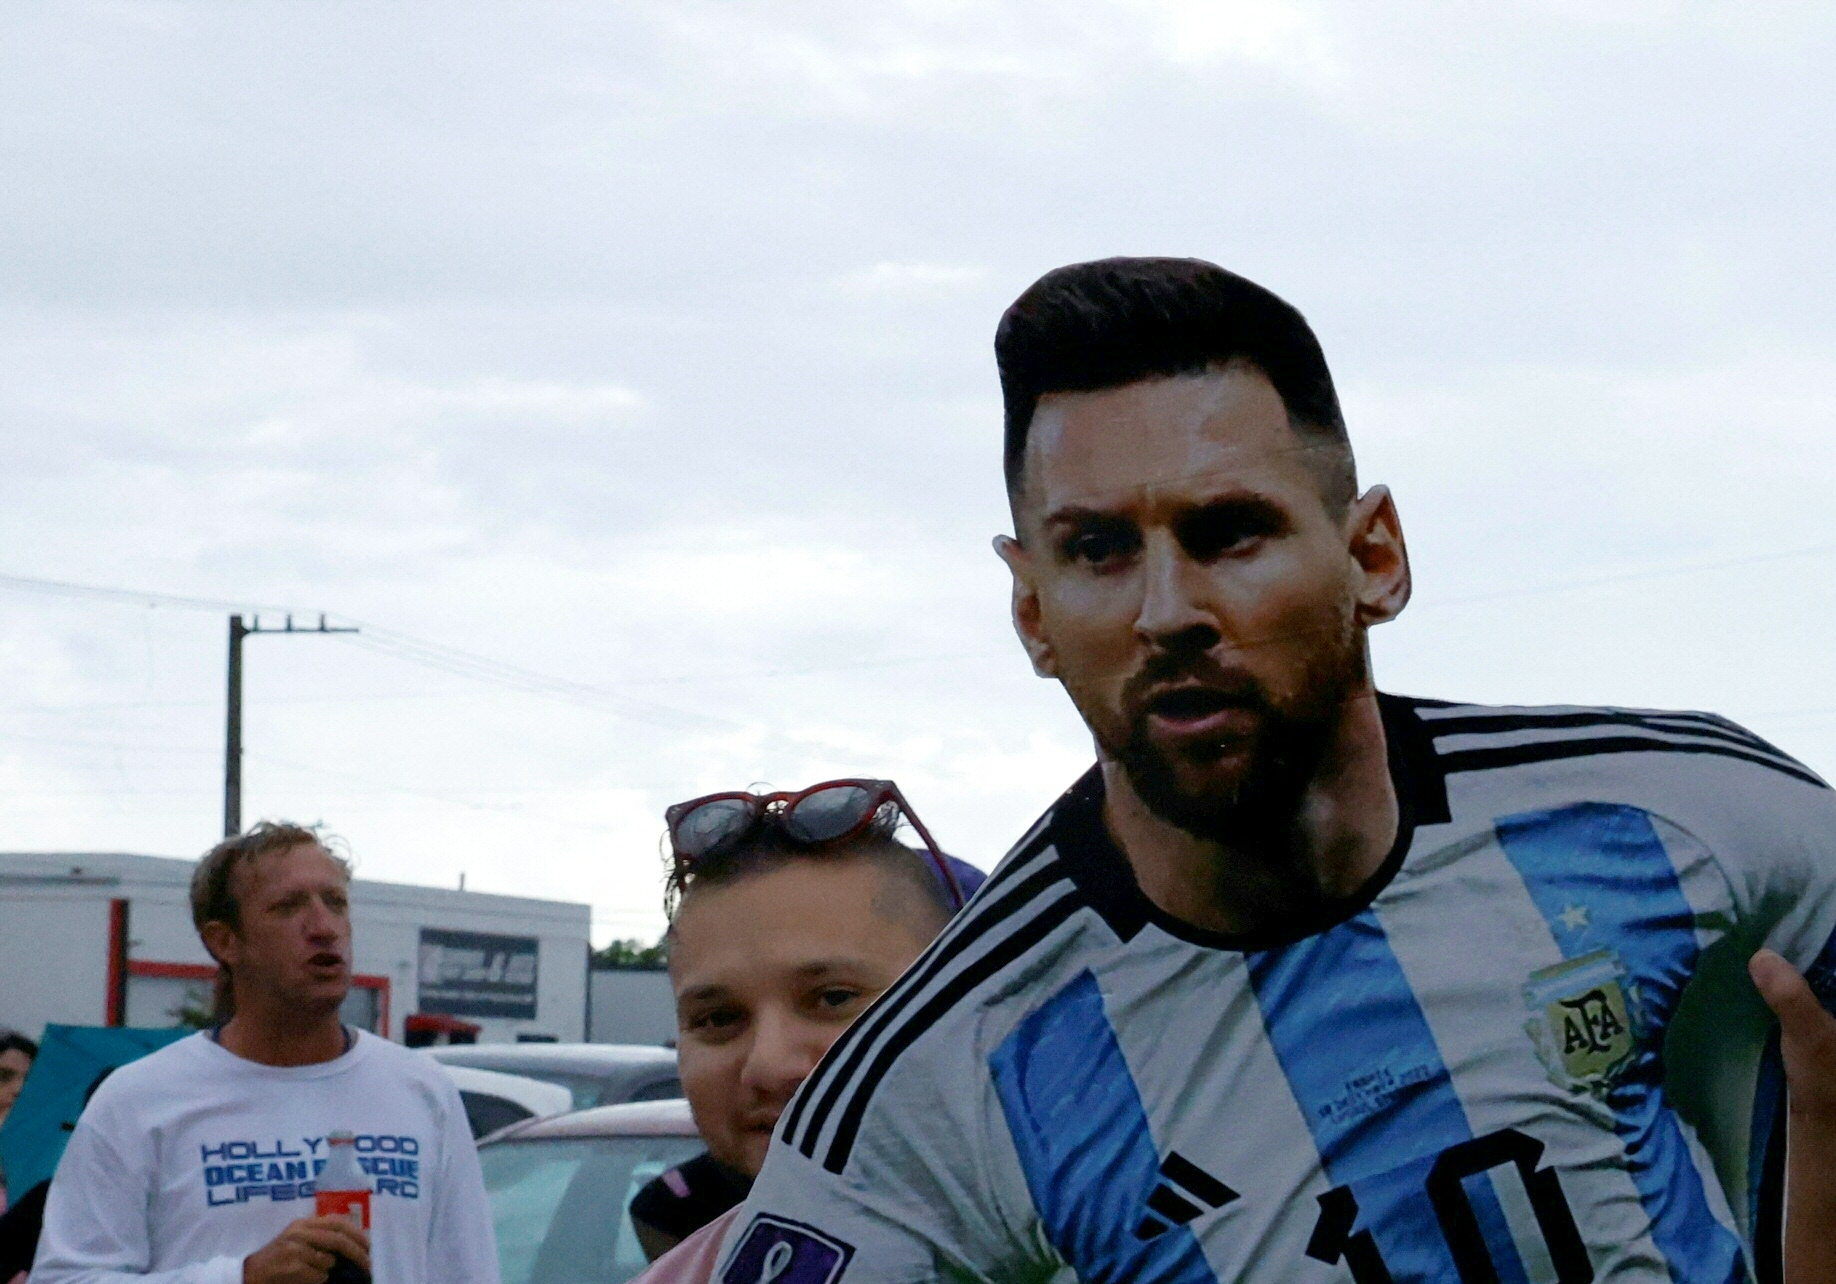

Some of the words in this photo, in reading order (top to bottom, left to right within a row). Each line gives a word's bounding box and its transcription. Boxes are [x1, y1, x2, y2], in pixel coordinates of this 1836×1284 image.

[202, 1134, 419, 1163] HOLLYOOD
[204, 1159, 308, 1186] OCEAN
[207, 1177, 419, 1207] LIFEGRD
